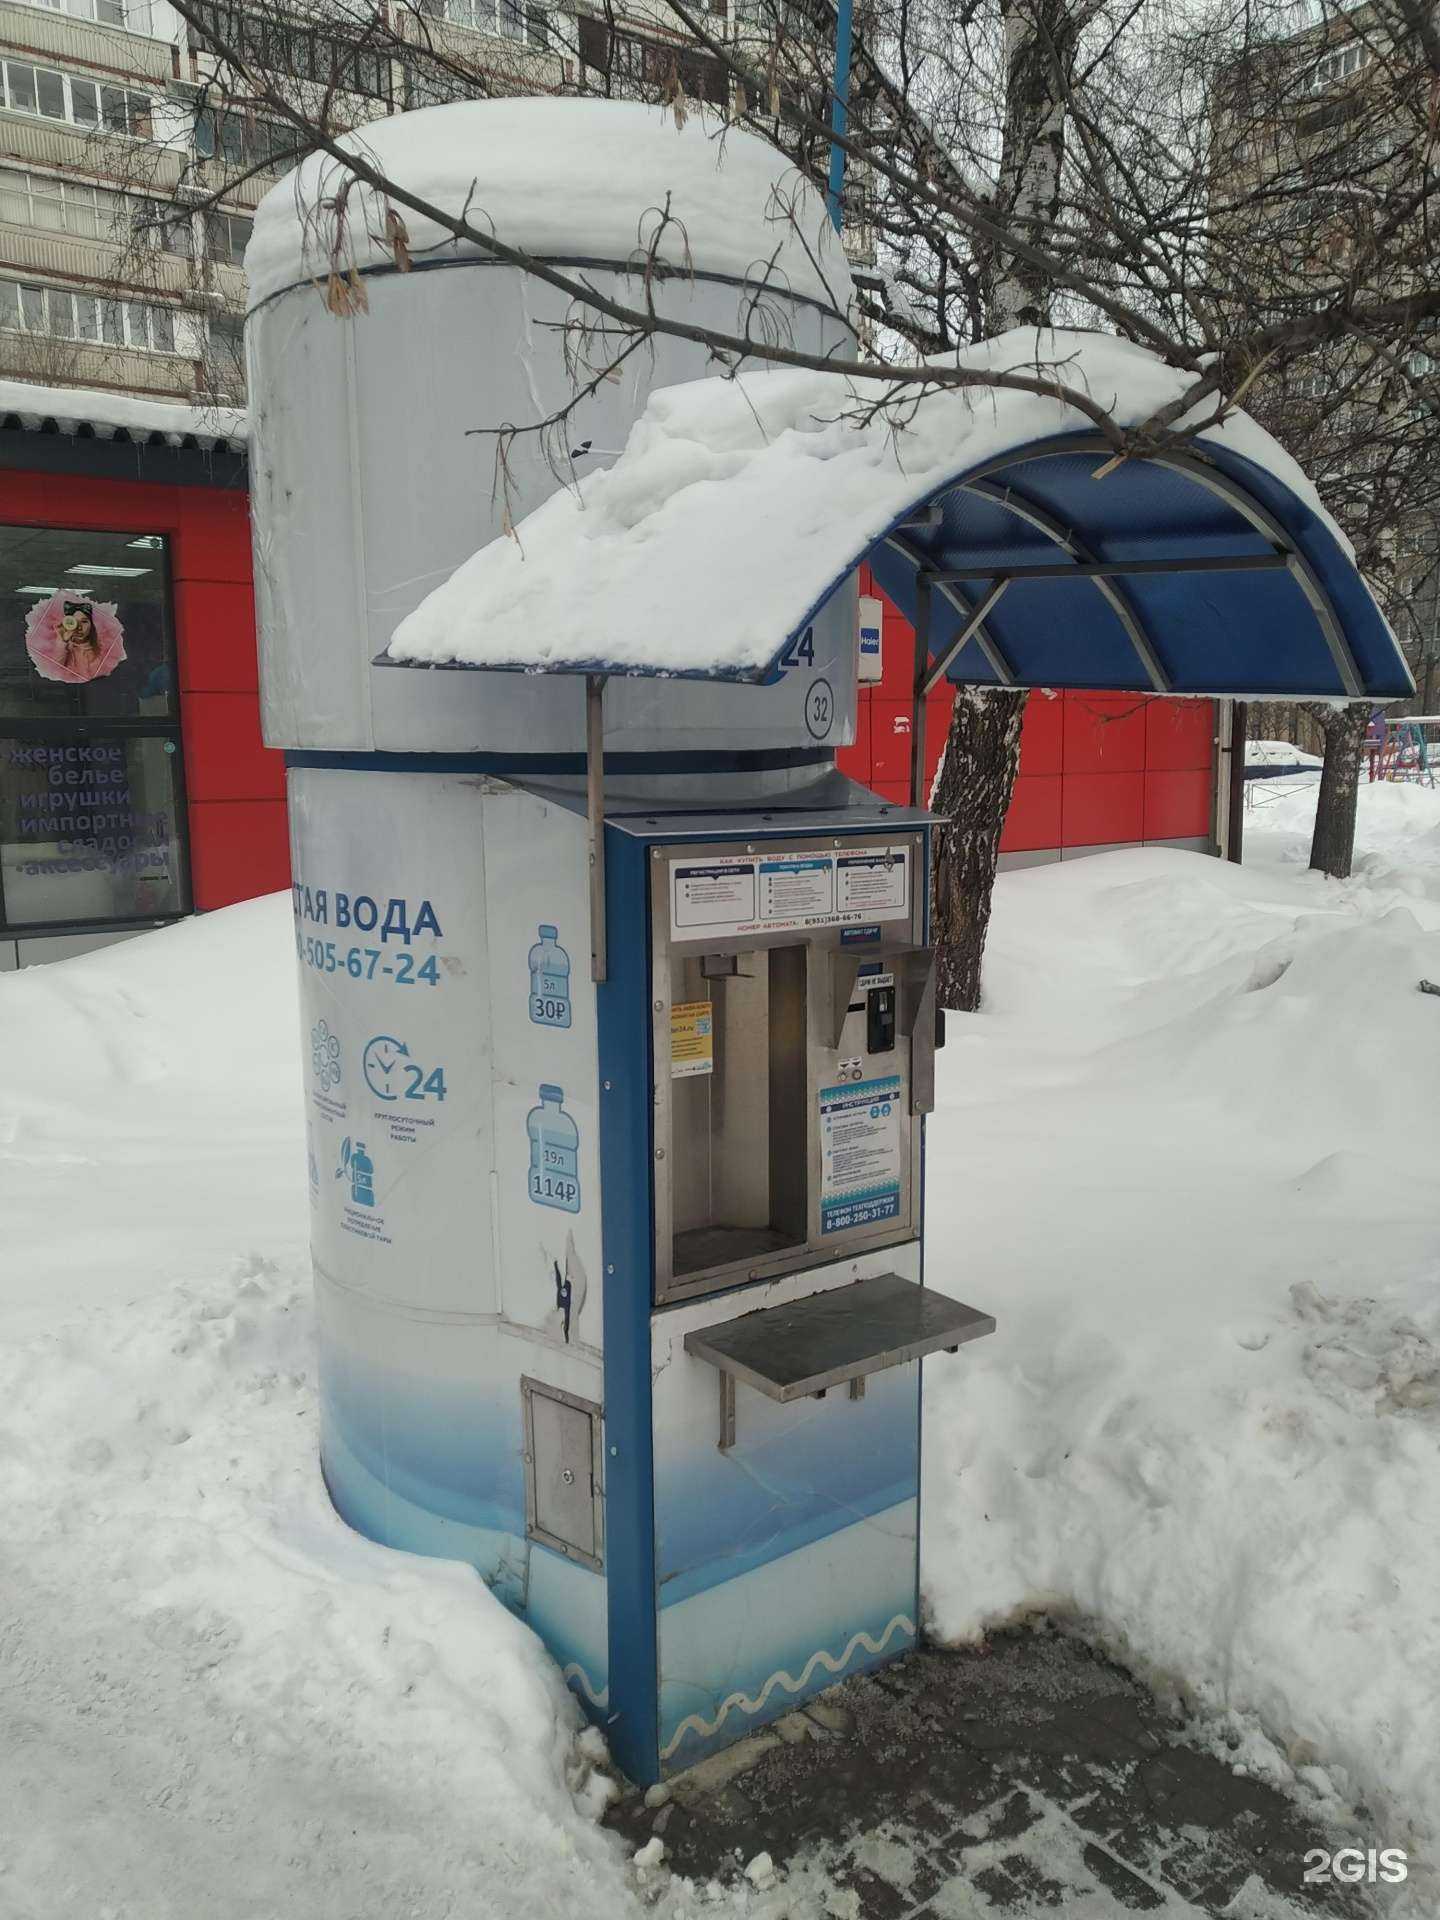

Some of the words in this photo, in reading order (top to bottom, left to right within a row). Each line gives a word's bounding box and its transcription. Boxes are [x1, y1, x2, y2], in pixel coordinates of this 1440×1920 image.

[814, 697, 828, 722] 32
[11, 746, 121, 763] женское
[49, 765, 124, 786] белье
[18, 789, 130, 812] игрушки
[336, 893, 443, 945] ВОДА
[403, 1065, 447, 1101] 24
[544, 1150, 564, 1166] 19л
